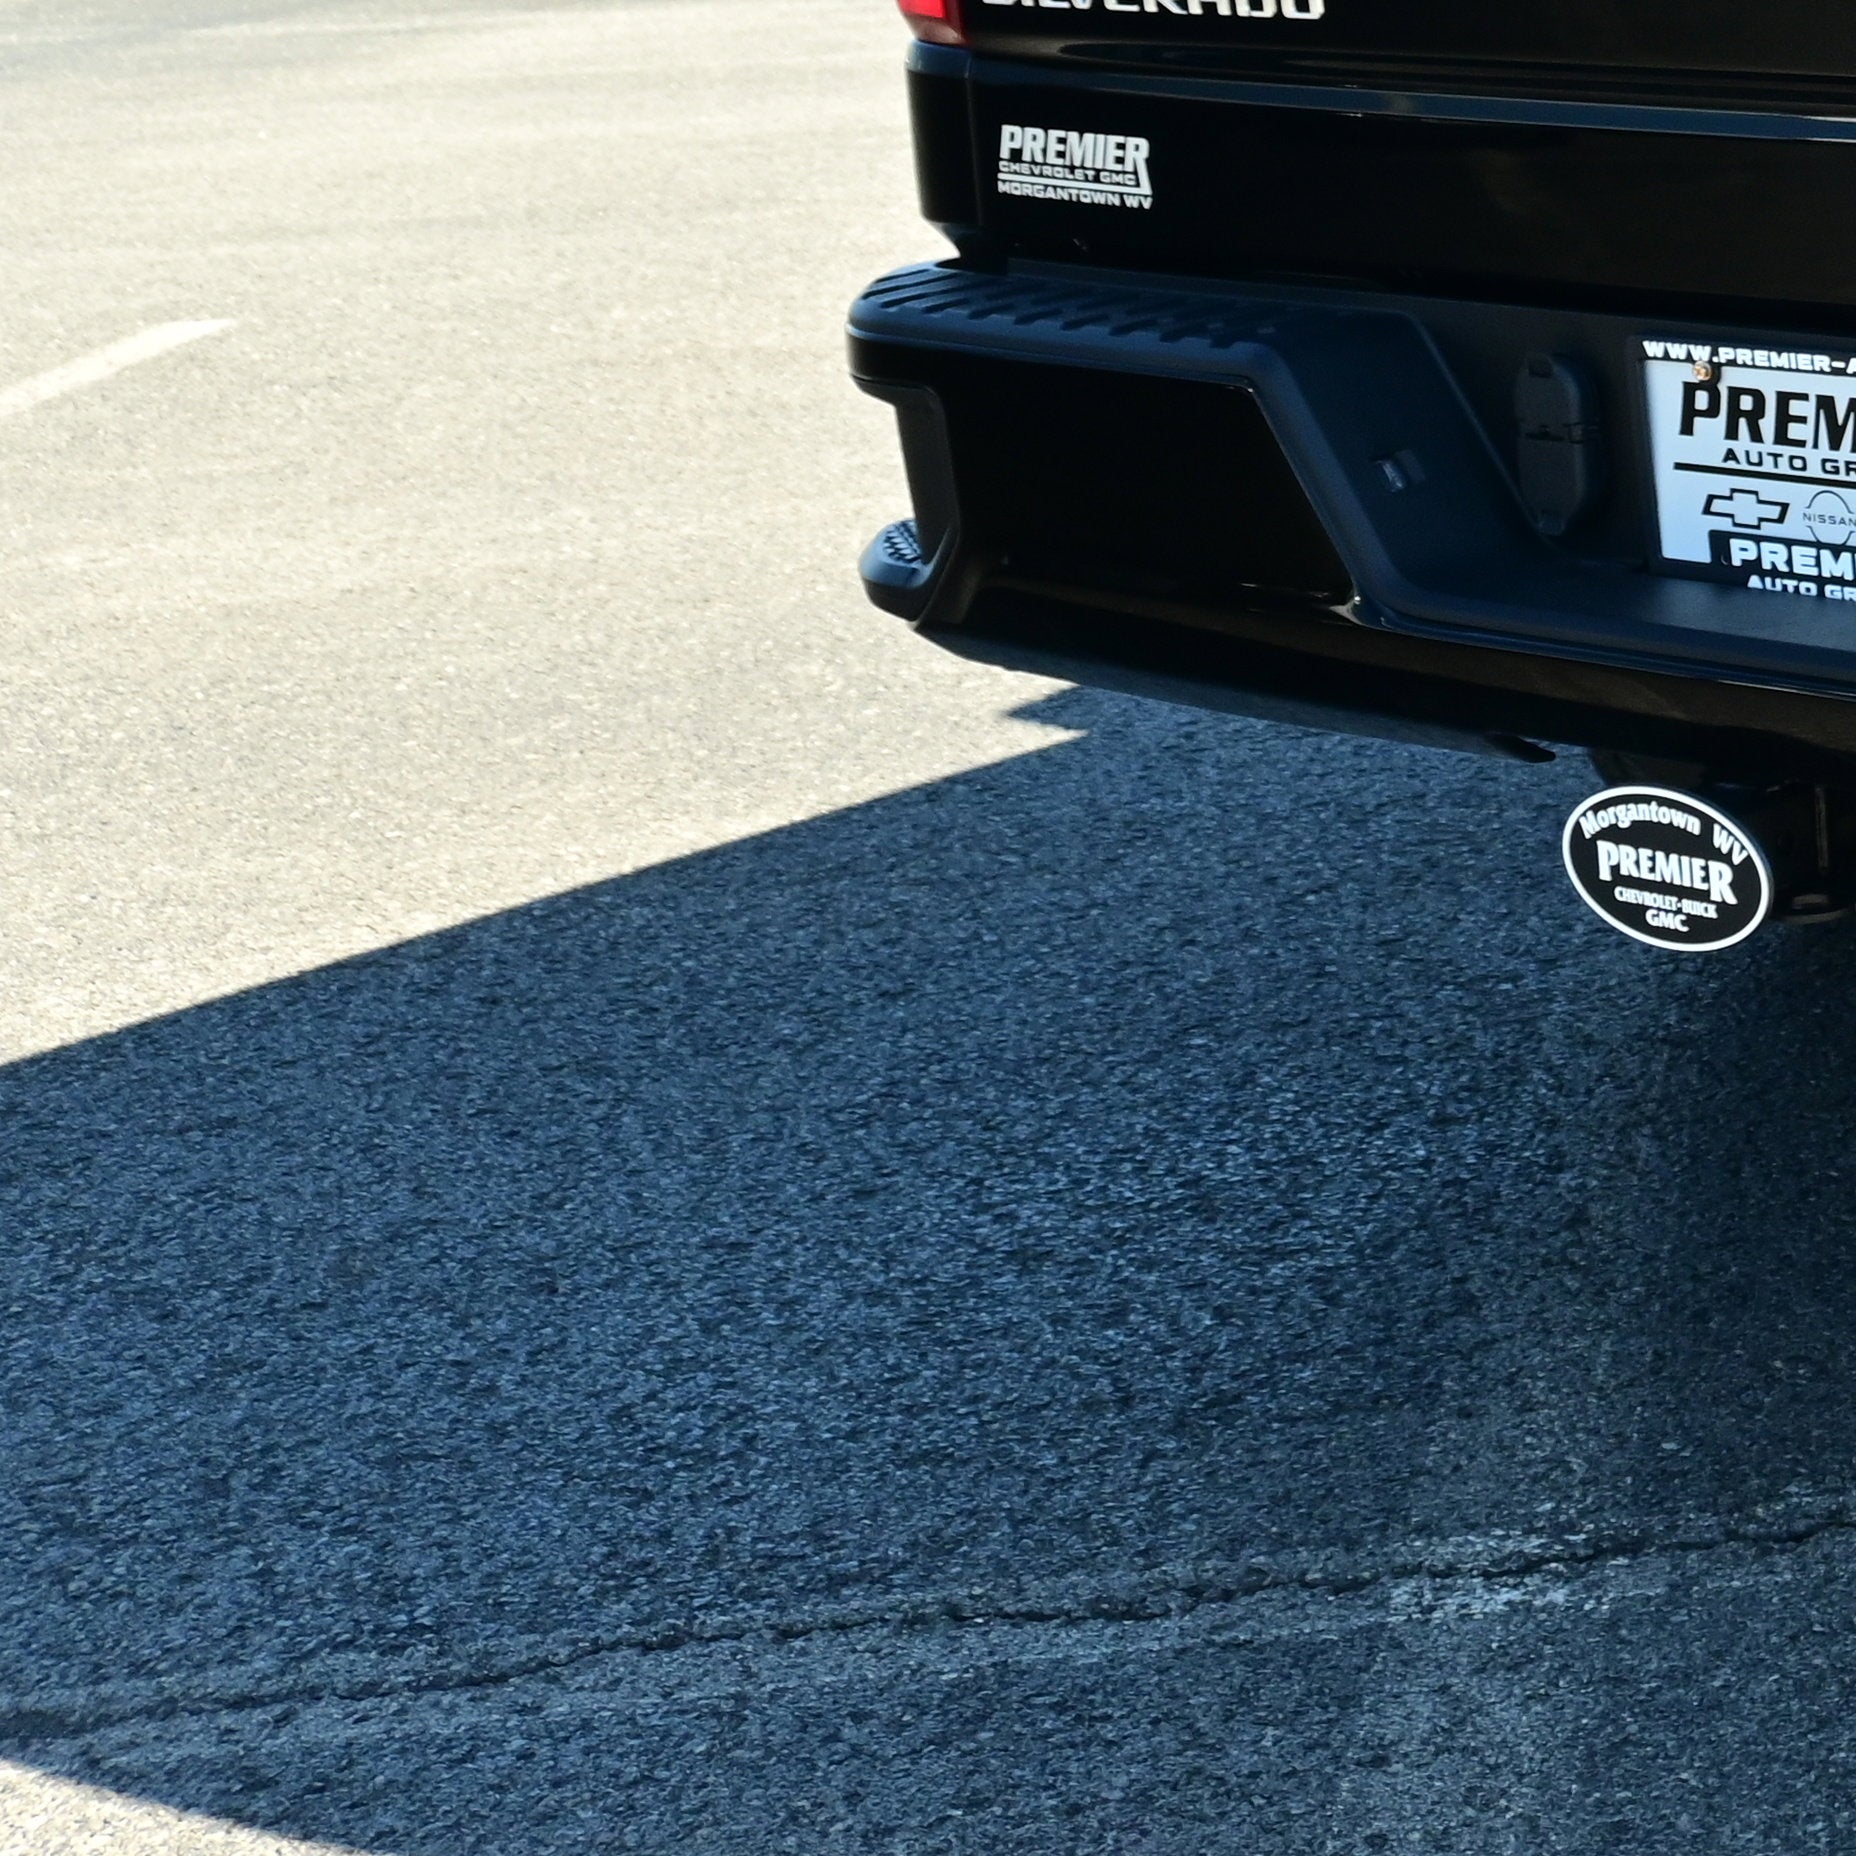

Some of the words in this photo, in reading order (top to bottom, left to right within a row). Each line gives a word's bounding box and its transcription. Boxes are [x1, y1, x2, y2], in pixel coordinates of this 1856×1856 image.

[1001, 124, 1151, 176] PREMIER
[999, 160, 1096, 181] CHEVROLET
[1099, 171, 1138, 186] GMC
[998, 180, 1121, 207] MORGANTOWN
[1123, 194, 1153, 210] WV
[1722, 447, 1808, 473] AUTO
[1747, 574, 1818, 596] AUTO
[1578, 800, 1701, 840] Morgantown
[1712, 823, 1749, 865] WV
[1596, 840, 1738, 905] PREMIER
[1645, 909, 1690, 933] GMC
